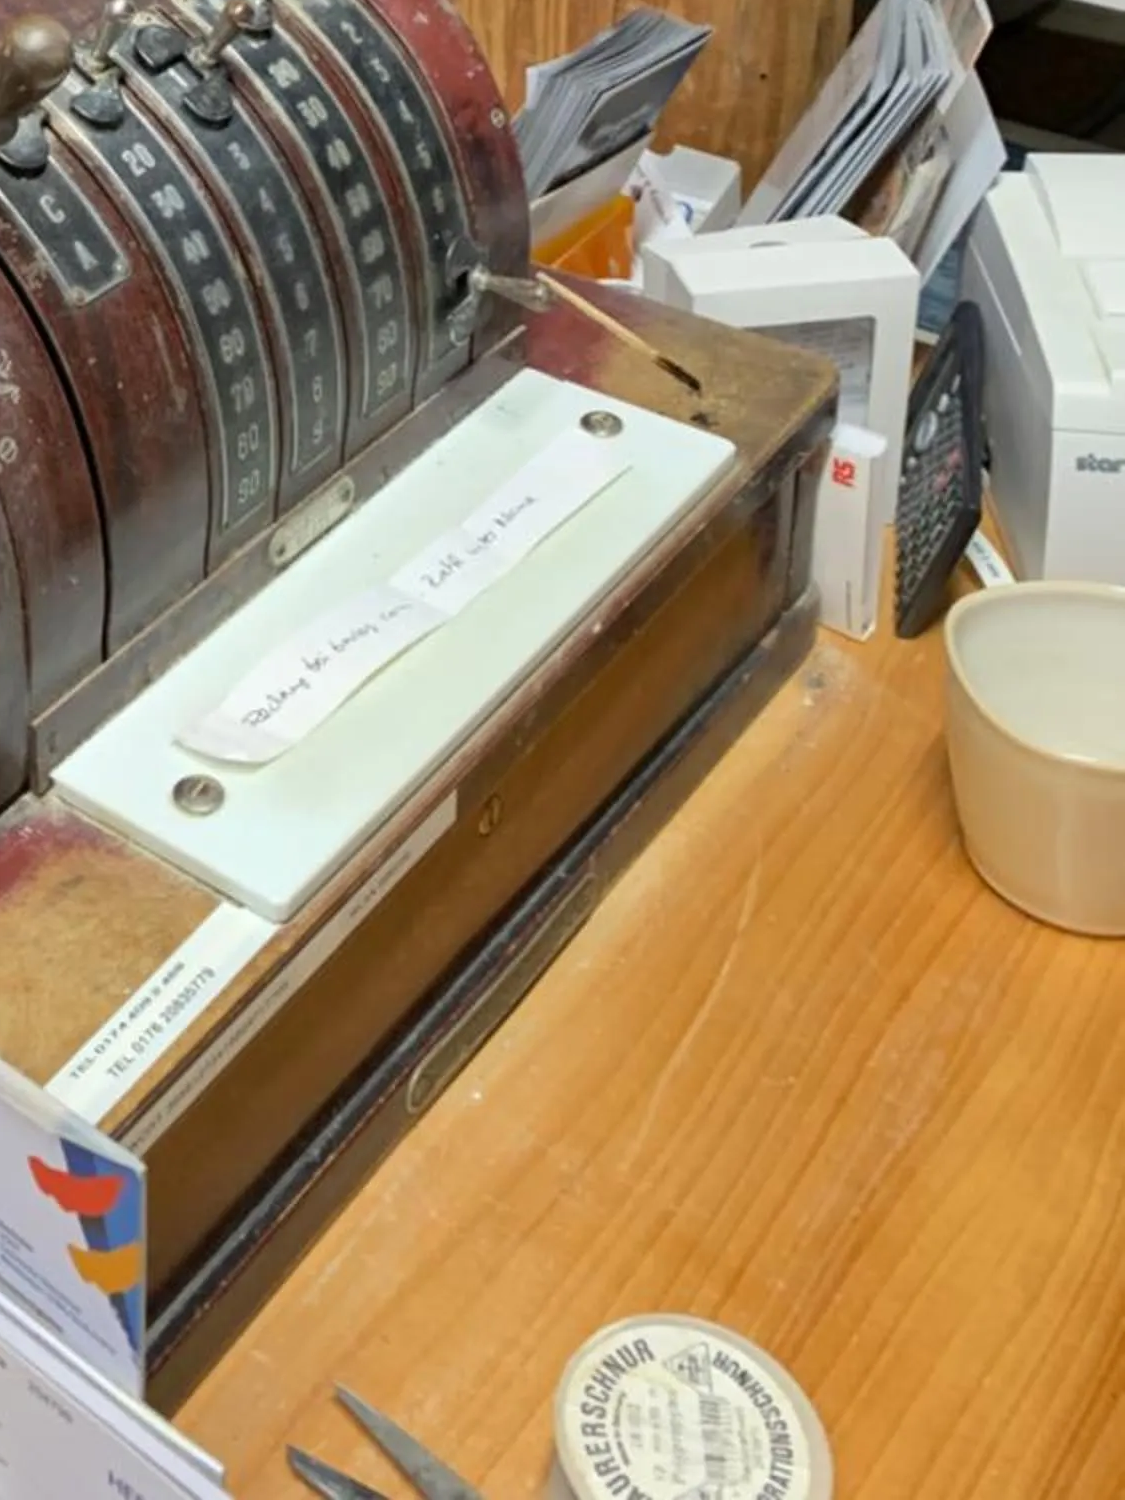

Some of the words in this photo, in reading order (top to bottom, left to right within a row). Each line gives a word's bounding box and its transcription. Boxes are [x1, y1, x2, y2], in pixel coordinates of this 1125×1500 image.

[121, 142, 156, 178] 20
[39, 194, 66, 224] C
[75, 240, 100, 272] A
[1076, 453, 1125, 473] star
[107, 1056, 136, 1077] TEL
